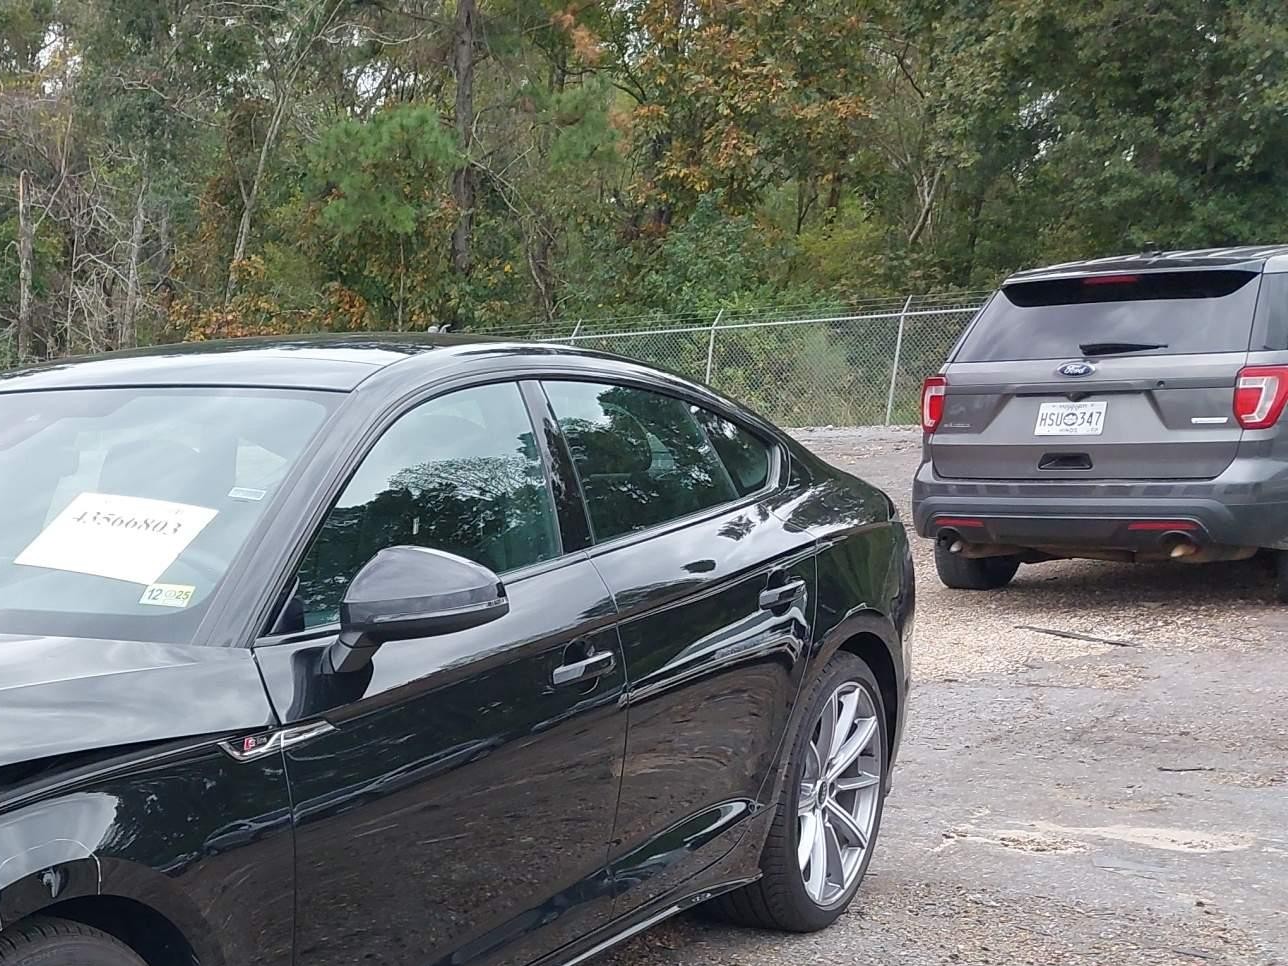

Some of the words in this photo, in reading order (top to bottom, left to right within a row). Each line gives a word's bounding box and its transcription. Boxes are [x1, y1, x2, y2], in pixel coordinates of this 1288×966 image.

[1063, 364, 1088, 374] Ford
[1039, 412, 1064, 427] HSU
[1078, 411, 1102, 427] 347
[72, 511, 182, 535] 43566803
[147, 588, 163, 601] 12
[175, 590, 191, 600] 25
